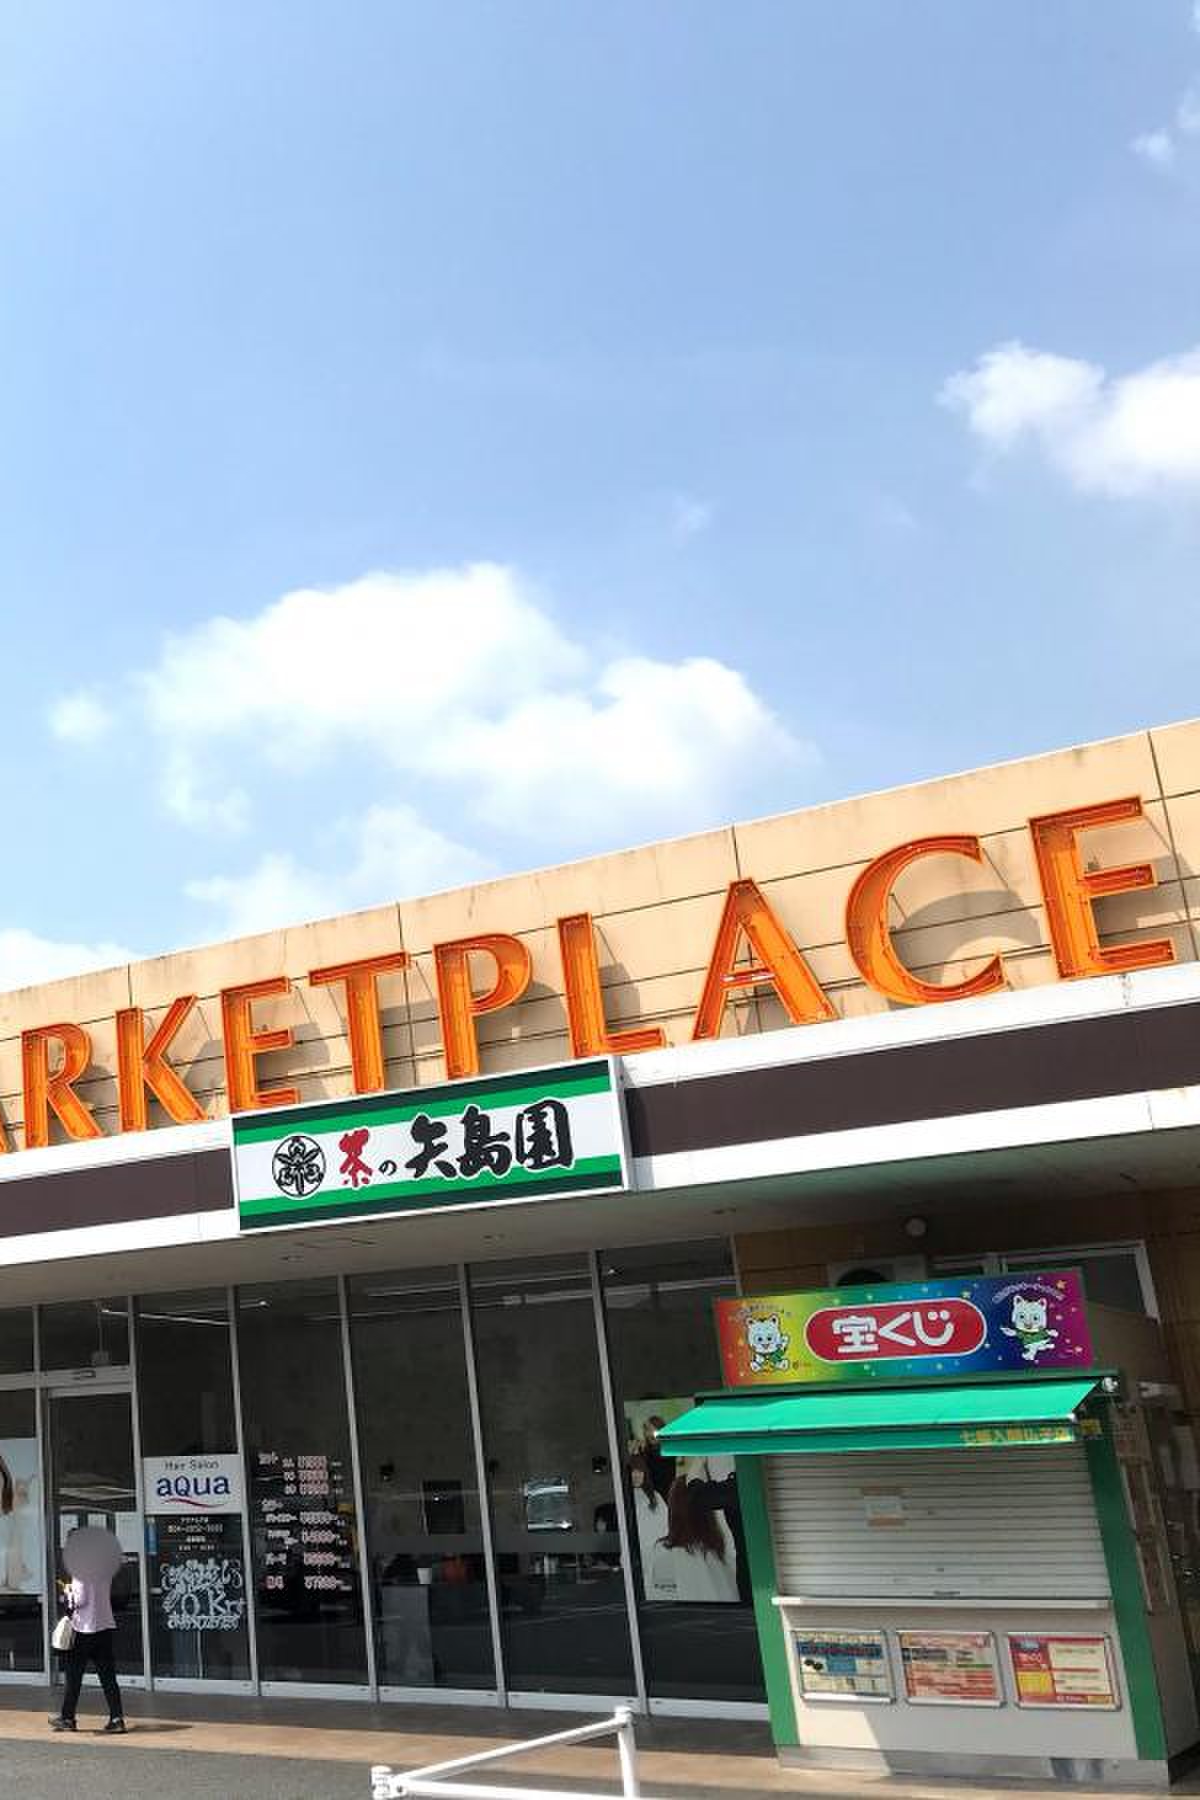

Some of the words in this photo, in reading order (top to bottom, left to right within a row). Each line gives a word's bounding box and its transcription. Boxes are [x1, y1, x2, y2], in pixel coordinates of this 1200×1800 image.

[338, 1099, 575, 1188] 茶の矢島園
[832, 1309, 955, 1354] 宝くじ
[164, 1461, 186, 1471] Hair
[189, 1458, 220, 1471] Salon
